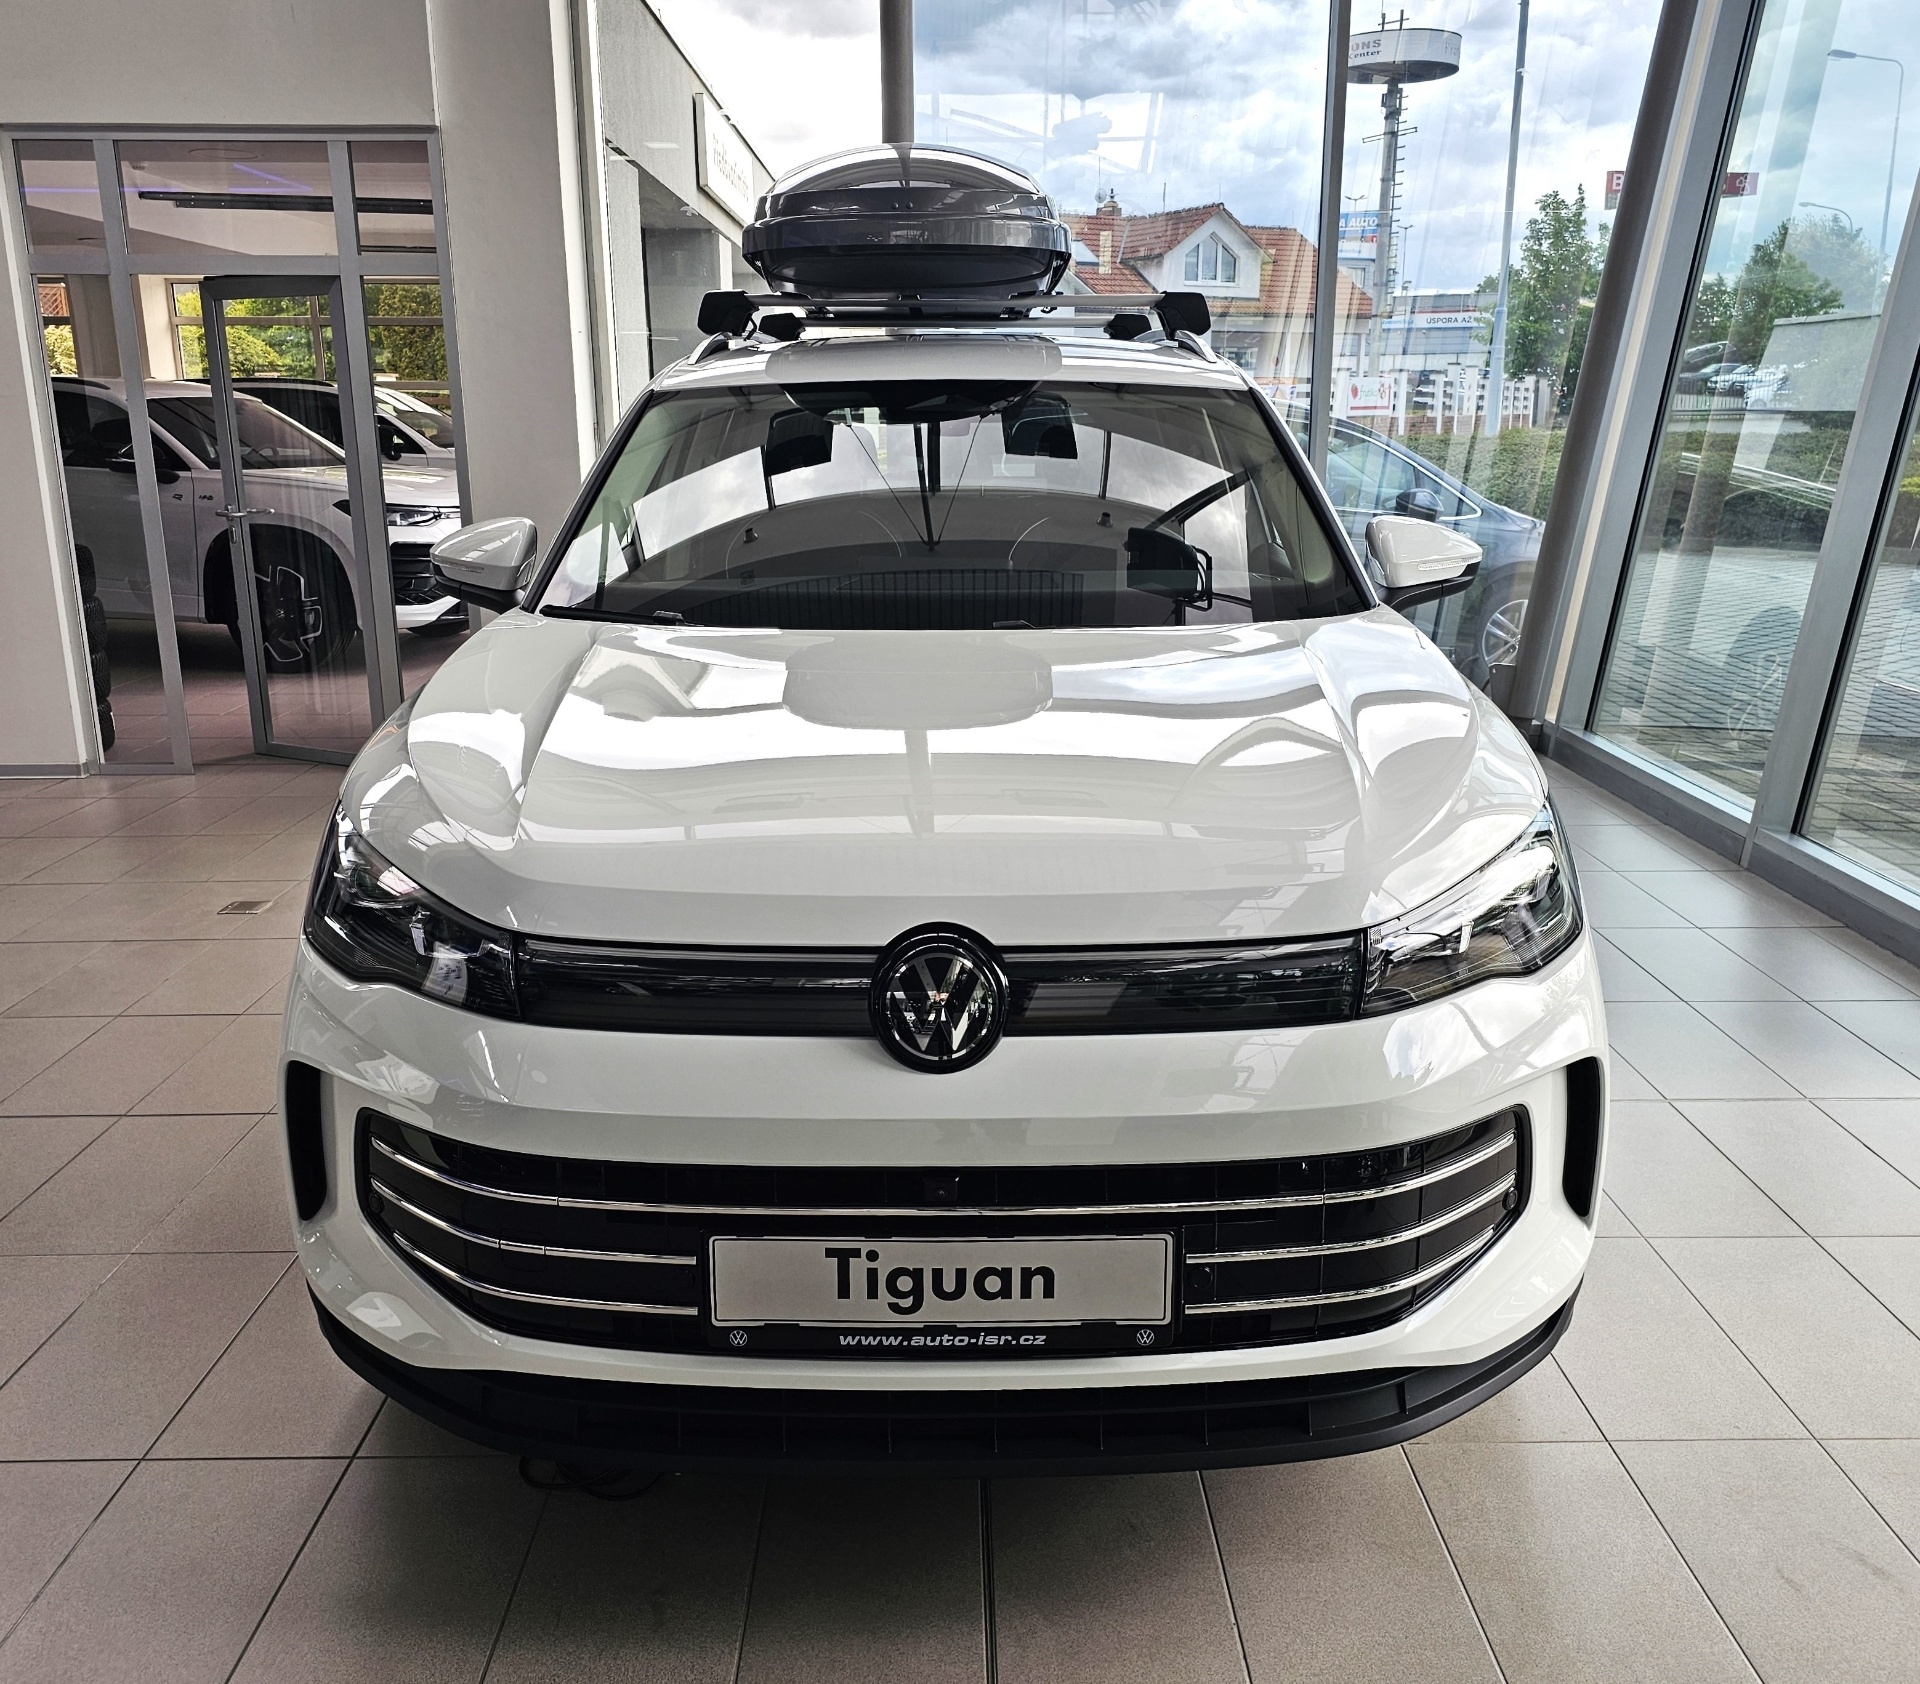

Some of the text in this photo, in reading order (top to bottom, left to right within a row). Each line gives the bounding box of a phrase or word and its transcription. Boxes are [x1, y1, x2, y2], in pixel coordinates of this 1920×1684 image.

[1348, 216, 1378, 228] AUTO
[824, 1247, 1055, 1315] Tiguan
[839, 1332, 1047, 1346] www.auto-isr.cz
